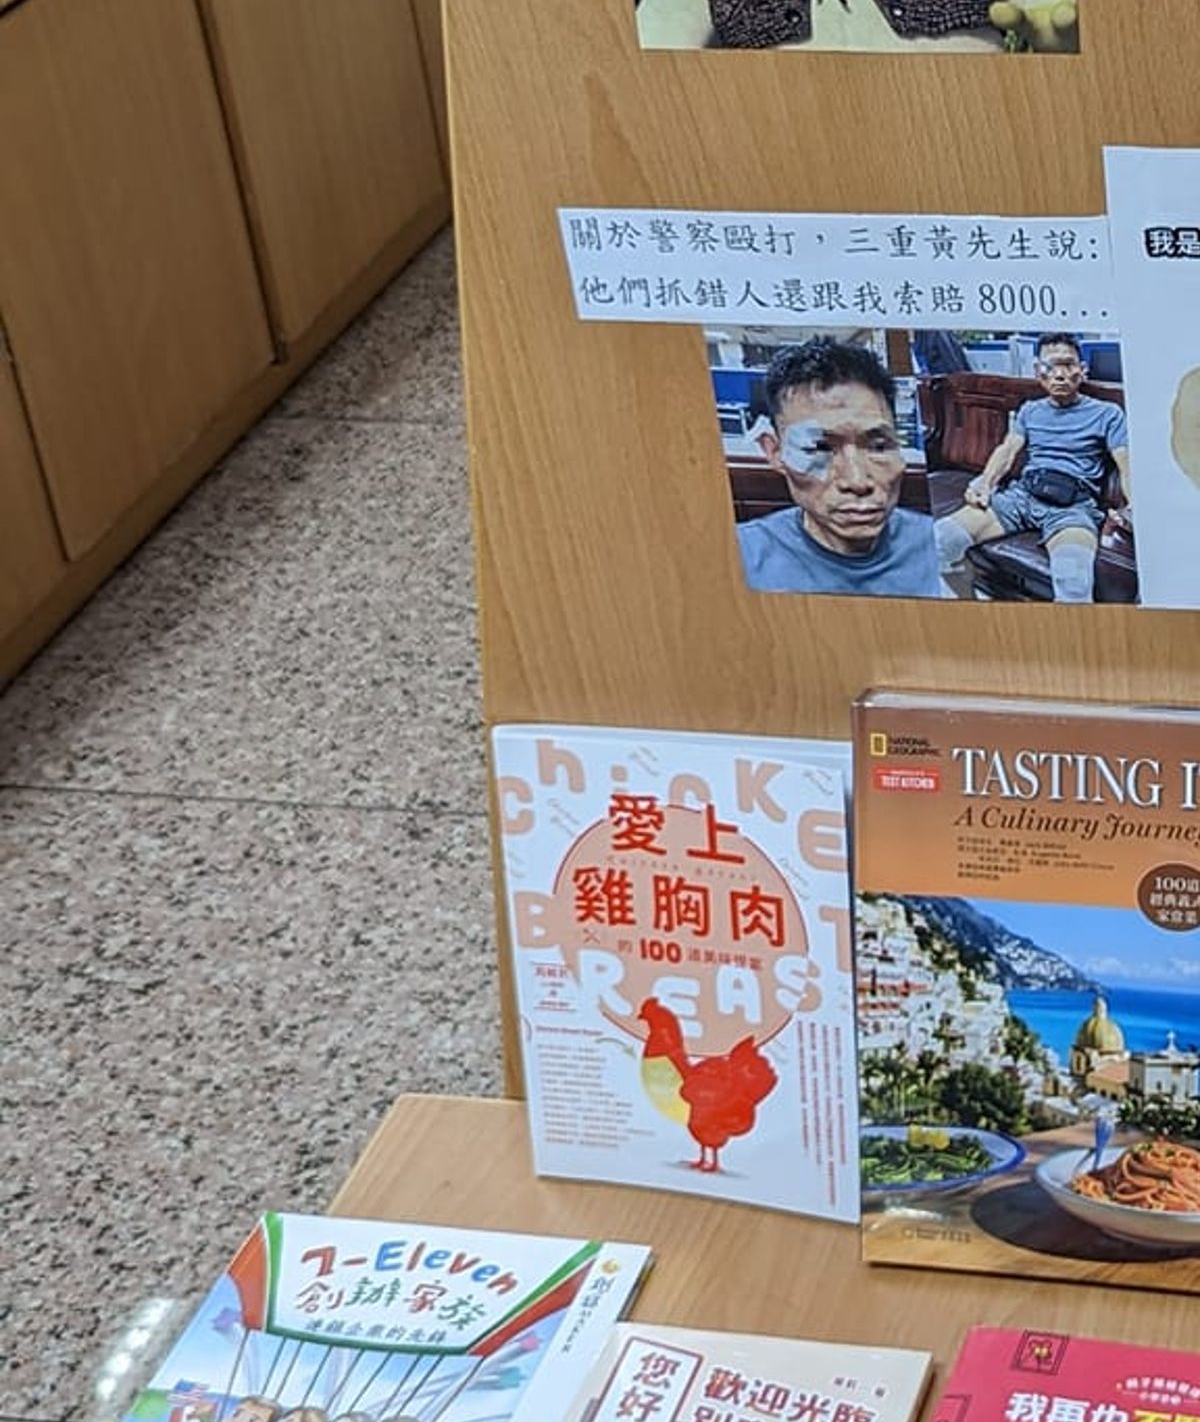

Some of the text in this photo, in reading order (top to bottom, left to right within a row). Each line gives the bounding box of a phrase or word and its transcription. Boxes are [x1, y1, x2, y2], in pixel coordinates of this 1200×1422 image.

[579, 275, 965, 318] 他們抓錯人還跟我索賠
[952, 747, 1163, 808] TASTING
[609, 792, 745, 865] 愛上
[953, 805, 974, 827] A
[980, 806, 1099, 840] Culinary
[572, 865, 785, 948] 雞胸肉
[301, 1240, 519, 1295] 7-Eleven
